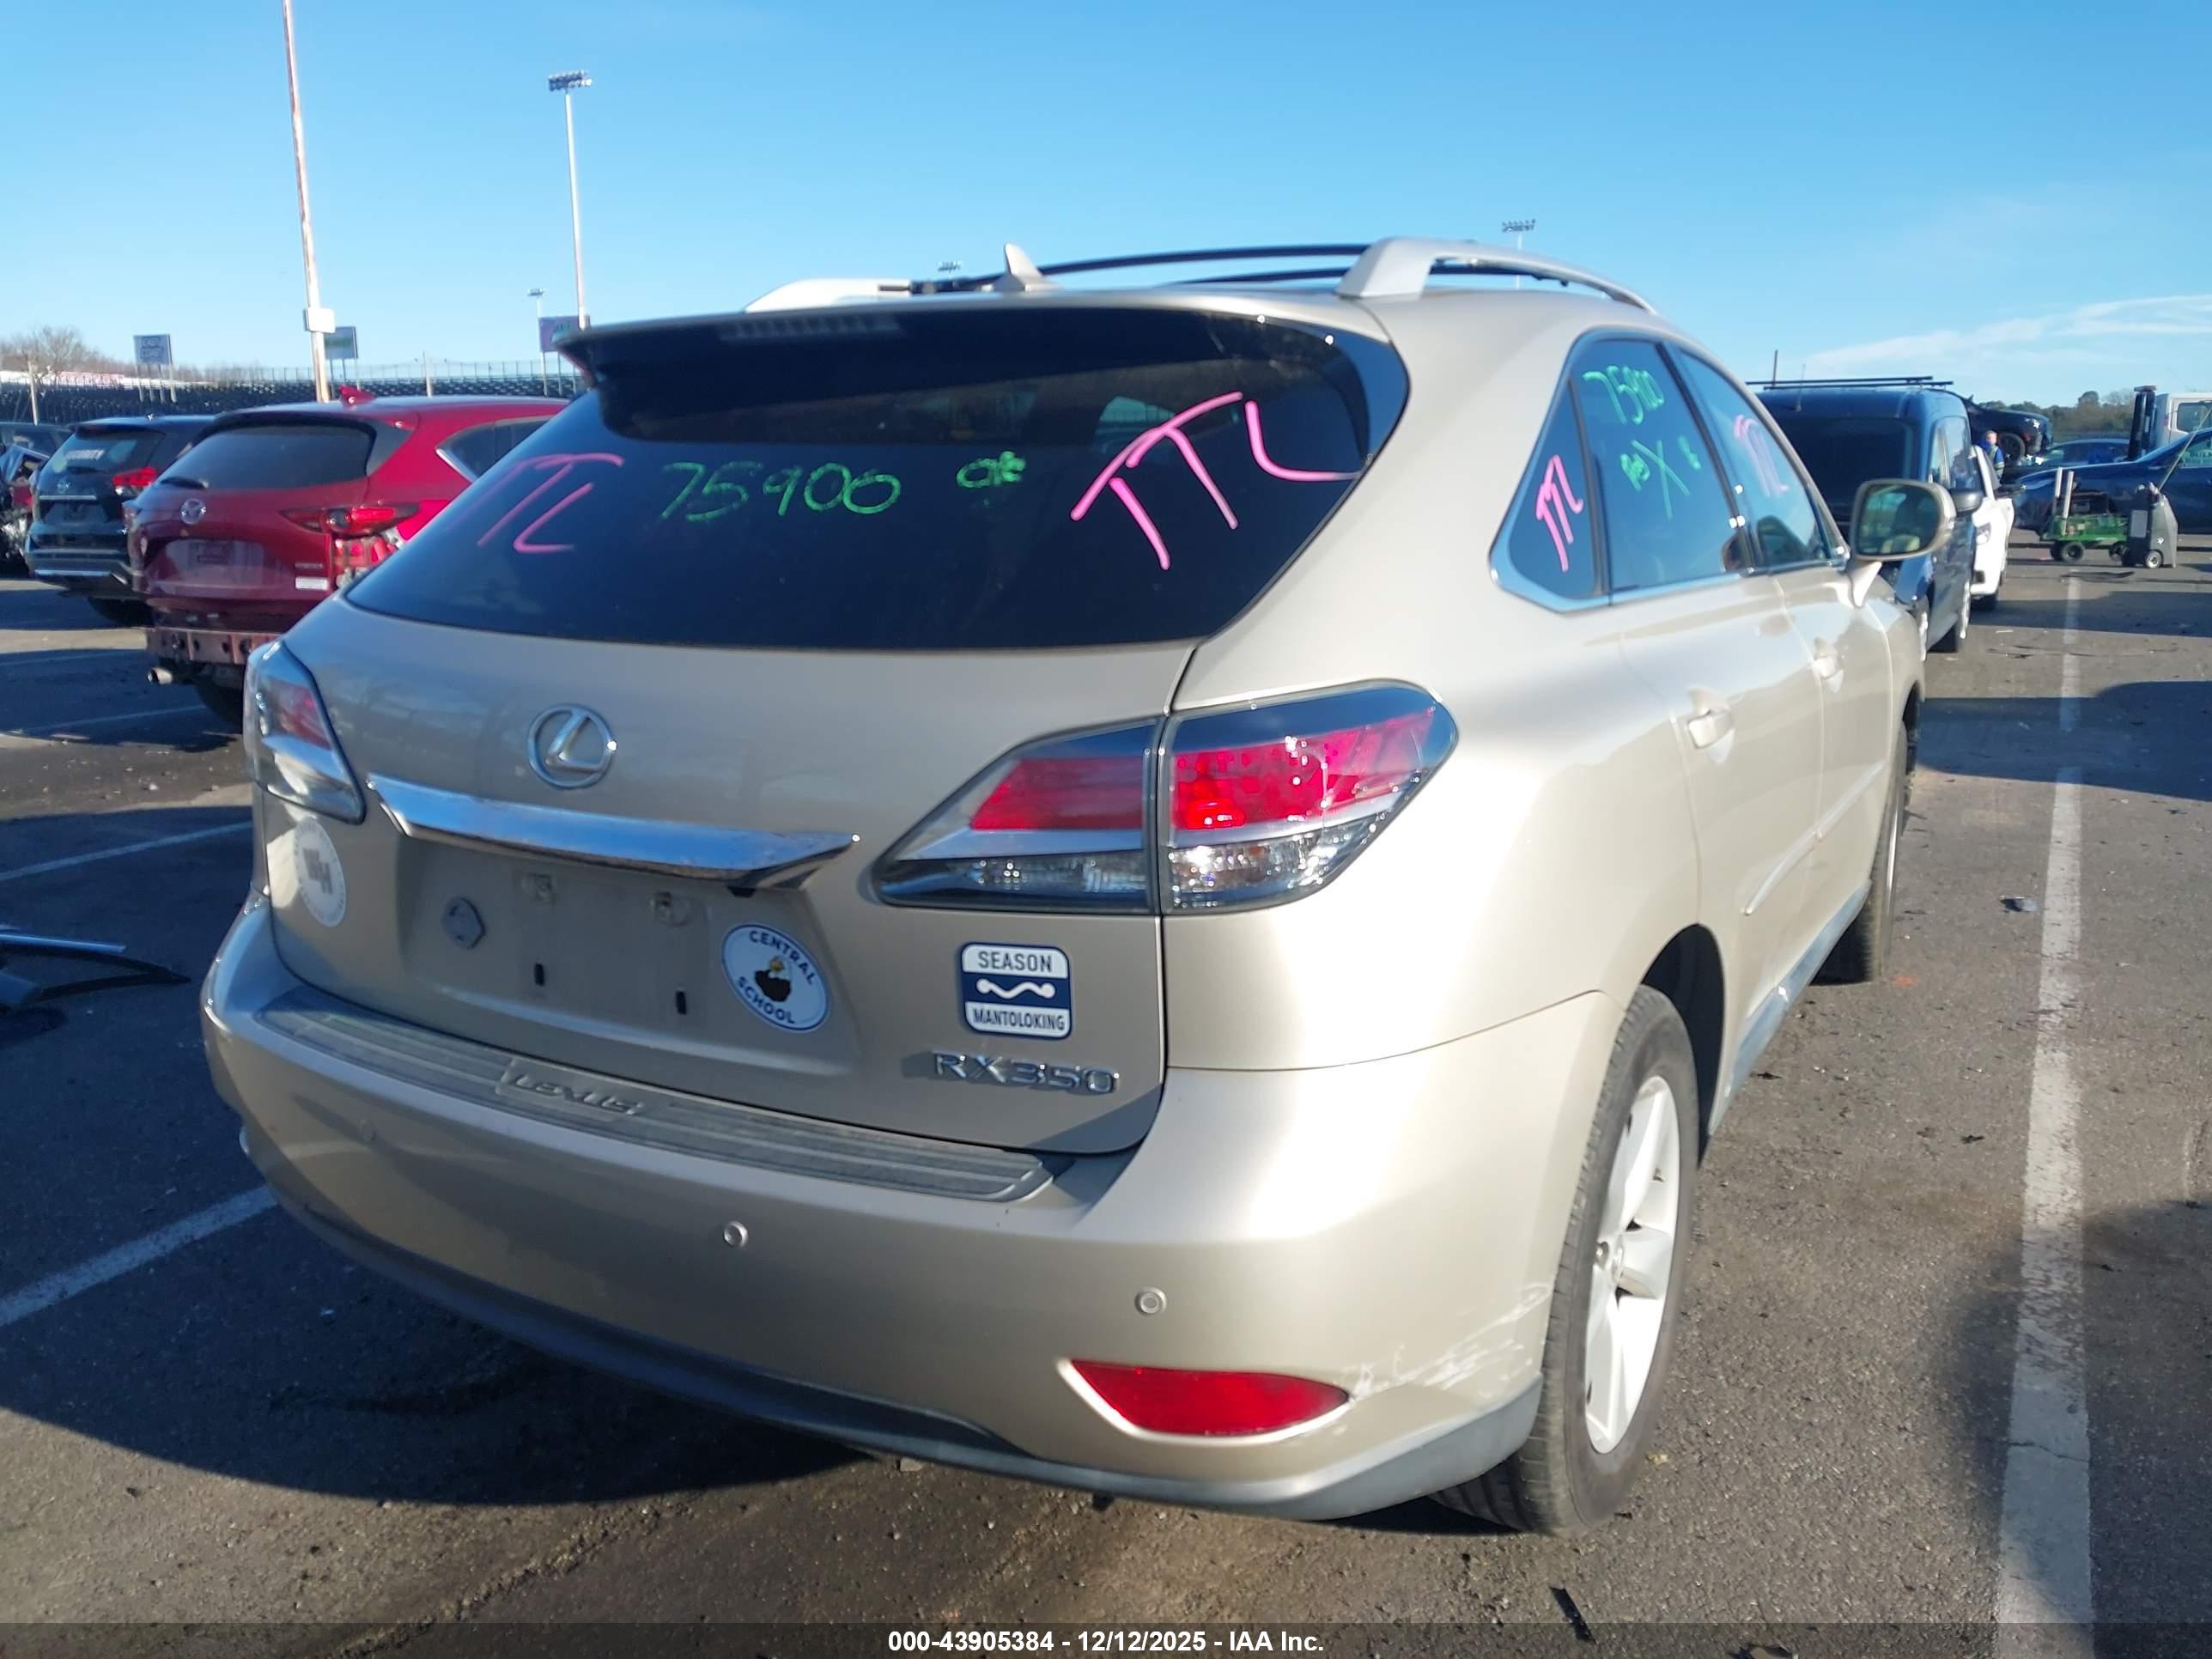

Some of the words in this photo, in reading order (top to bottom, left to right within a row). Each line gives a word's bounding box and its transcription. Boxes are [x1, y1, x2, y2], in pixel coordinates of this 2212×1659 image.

[661, 462, 901, 521] 75900
[977, 950, 1053, 972] SEASON
[972, 1007, 1066, 1030] MANTOLOKING
